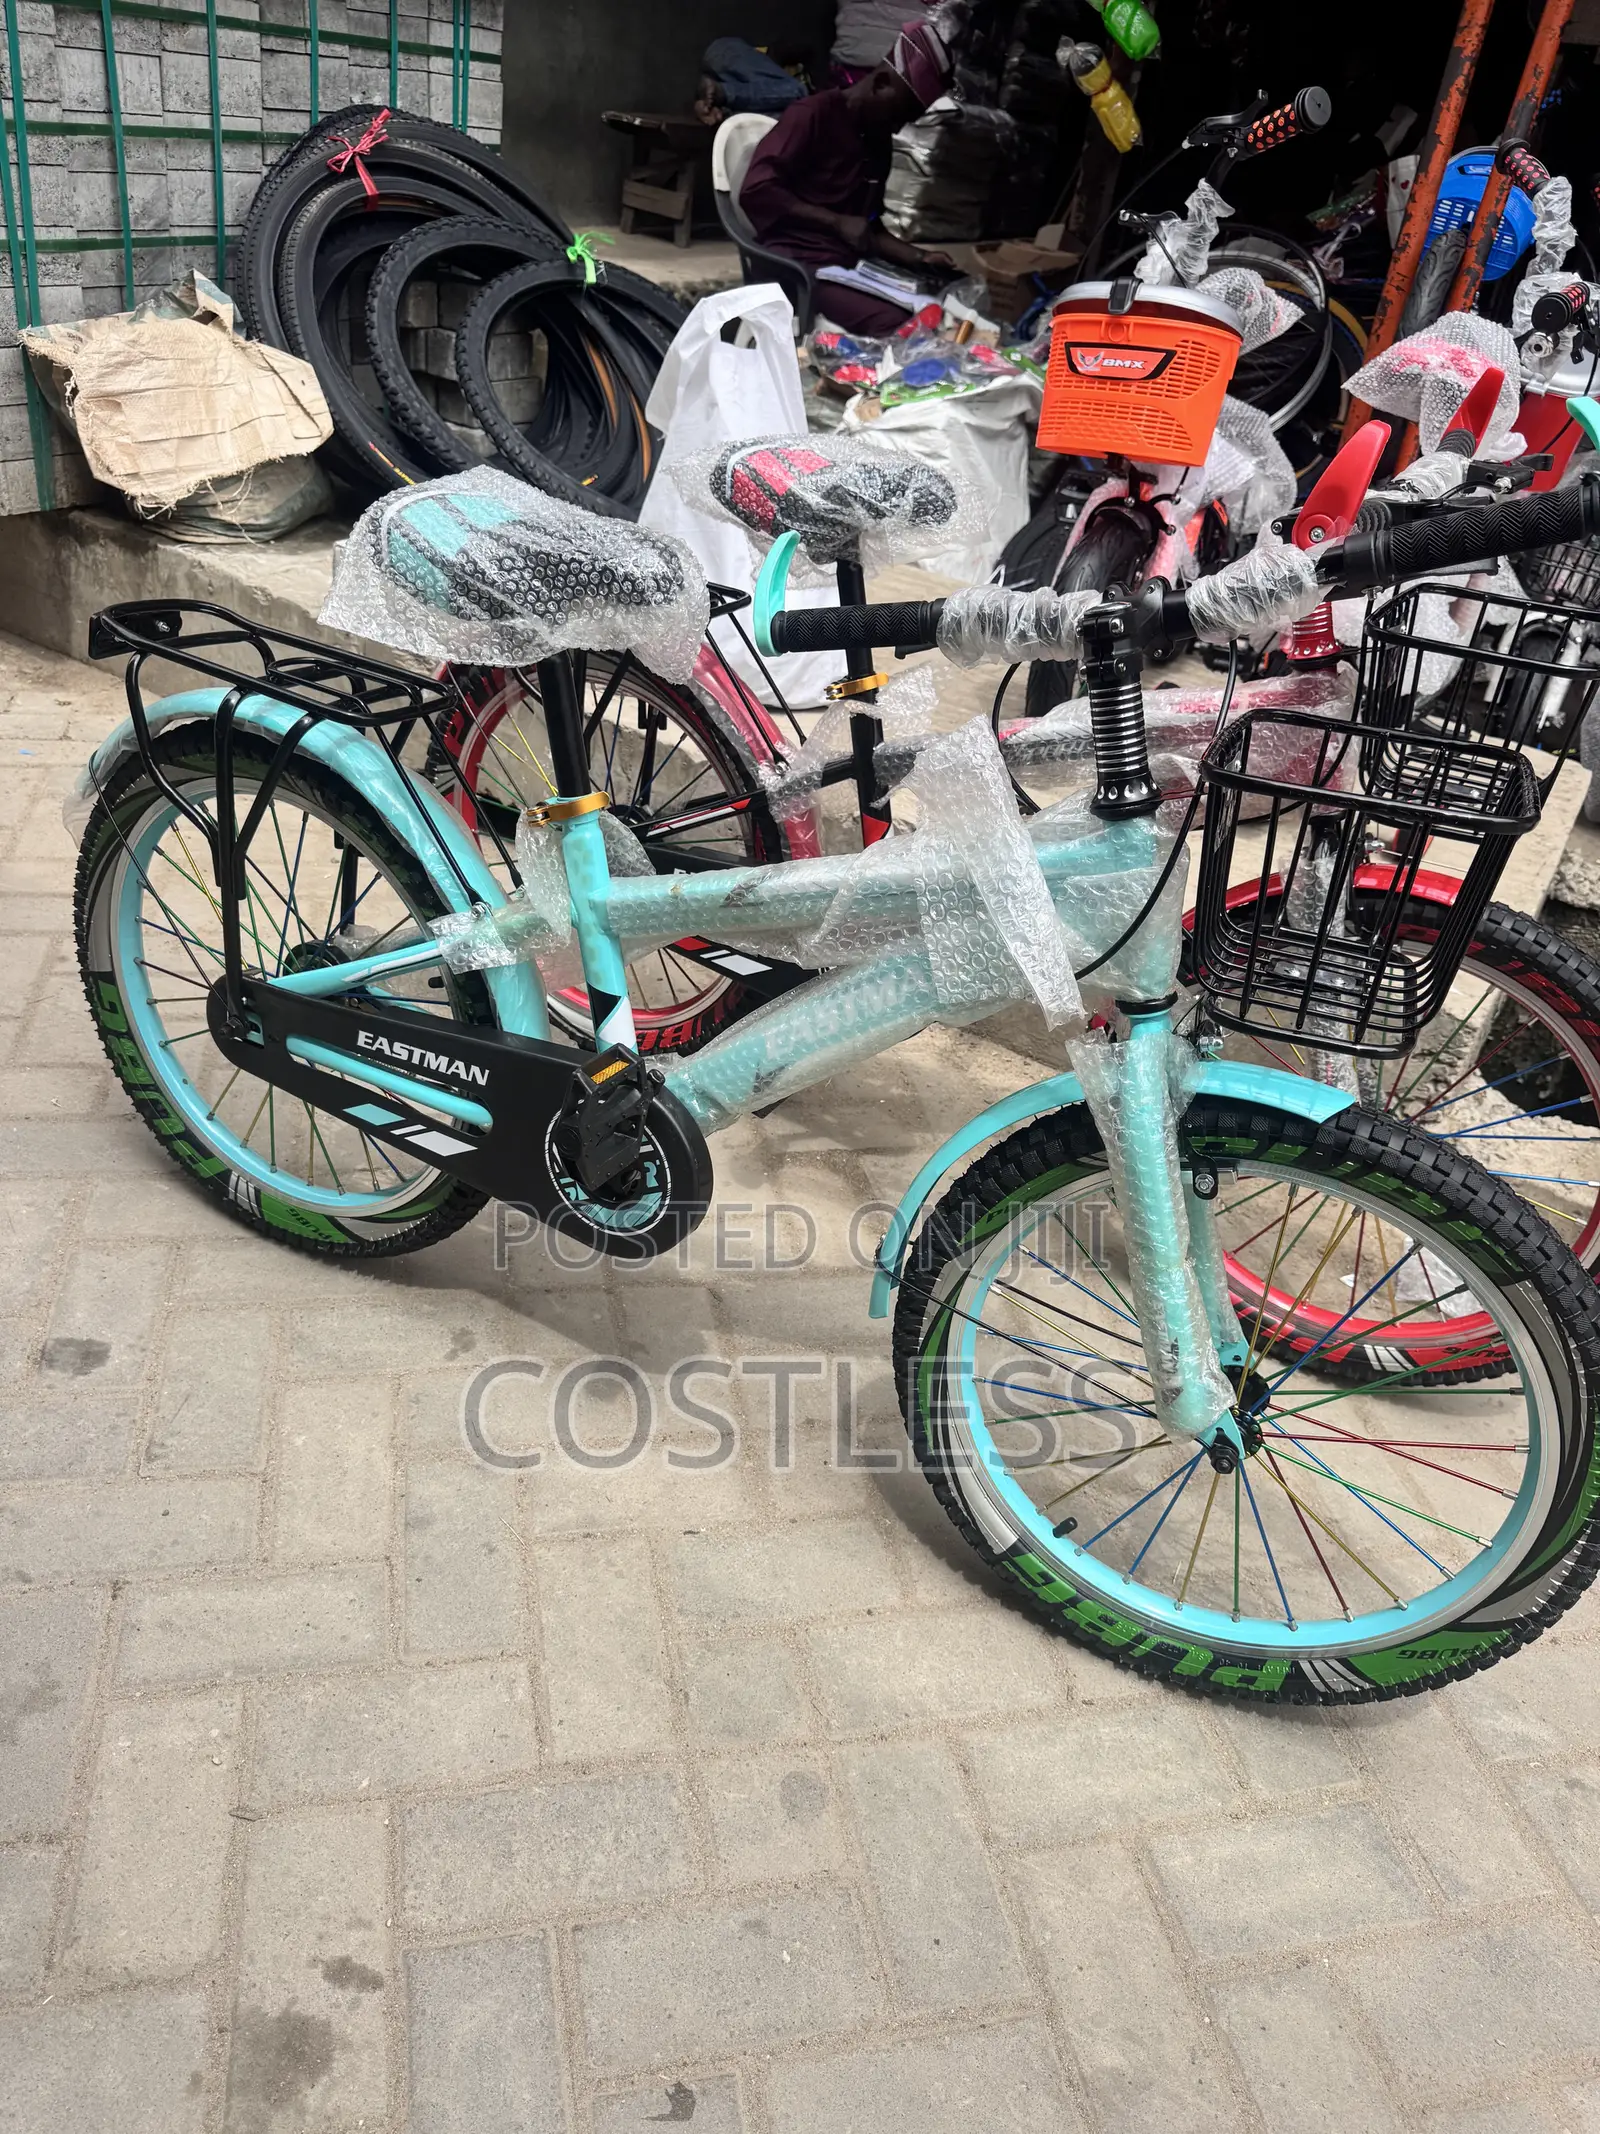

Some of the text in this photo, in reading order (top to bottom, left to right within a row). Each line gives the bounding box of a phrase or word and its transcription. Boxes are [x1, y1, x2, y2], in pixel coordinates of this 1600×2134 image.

[1101, 358, 1145, 369] BMX
[98, 980, 231, 1180] PUBG
[356, 1030, 490, 1086] EASTMAN
[286, 1208, 333, 1240] PUBG
[1002, 1552, 1293, 1692] PUBG
[1395, 1645, 1482, 1660] PUBG
